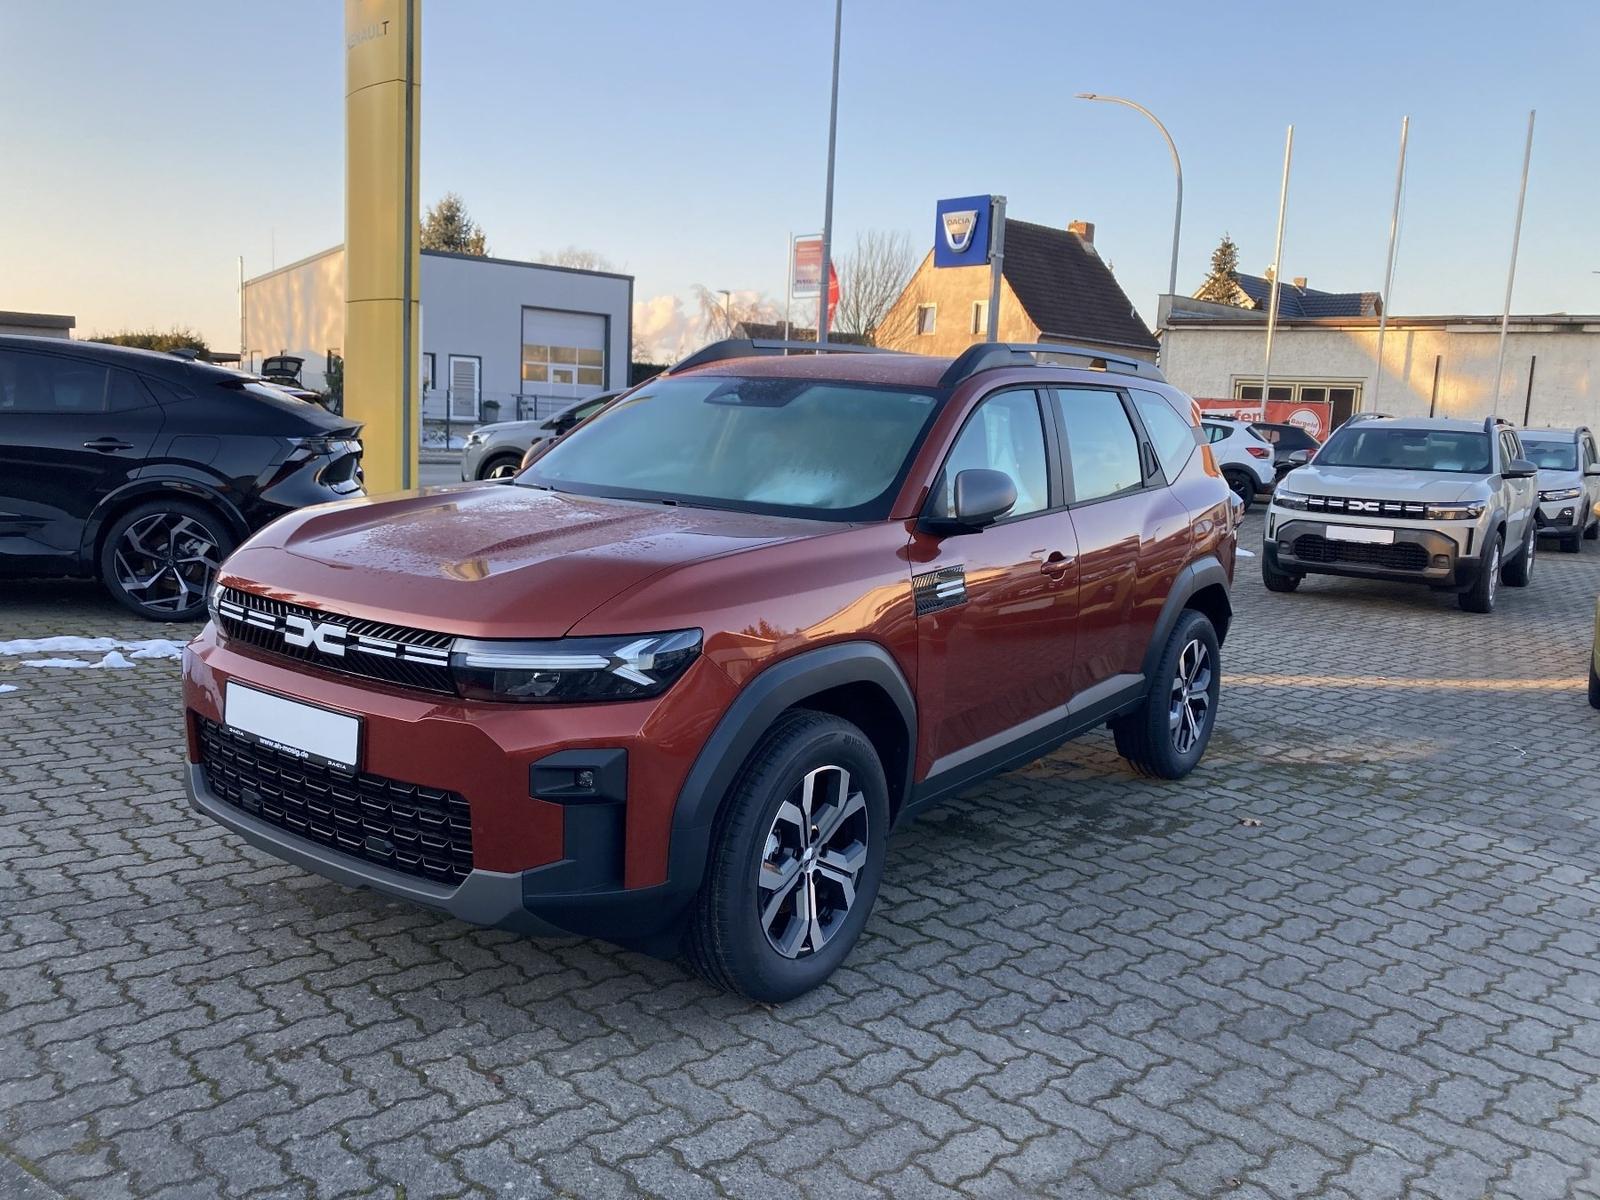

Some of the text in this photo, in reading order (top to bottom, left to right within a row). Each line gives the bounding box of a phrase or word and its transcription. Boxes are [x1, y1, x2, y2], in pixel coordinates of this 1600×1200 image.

[946, 217, 970, 225] DACIA
[1290, 418, 1318, 429] Bargeld
[259, 737, 309, 759] www.ah-mosig.de
[327, 760, 347, 770] DACIA
